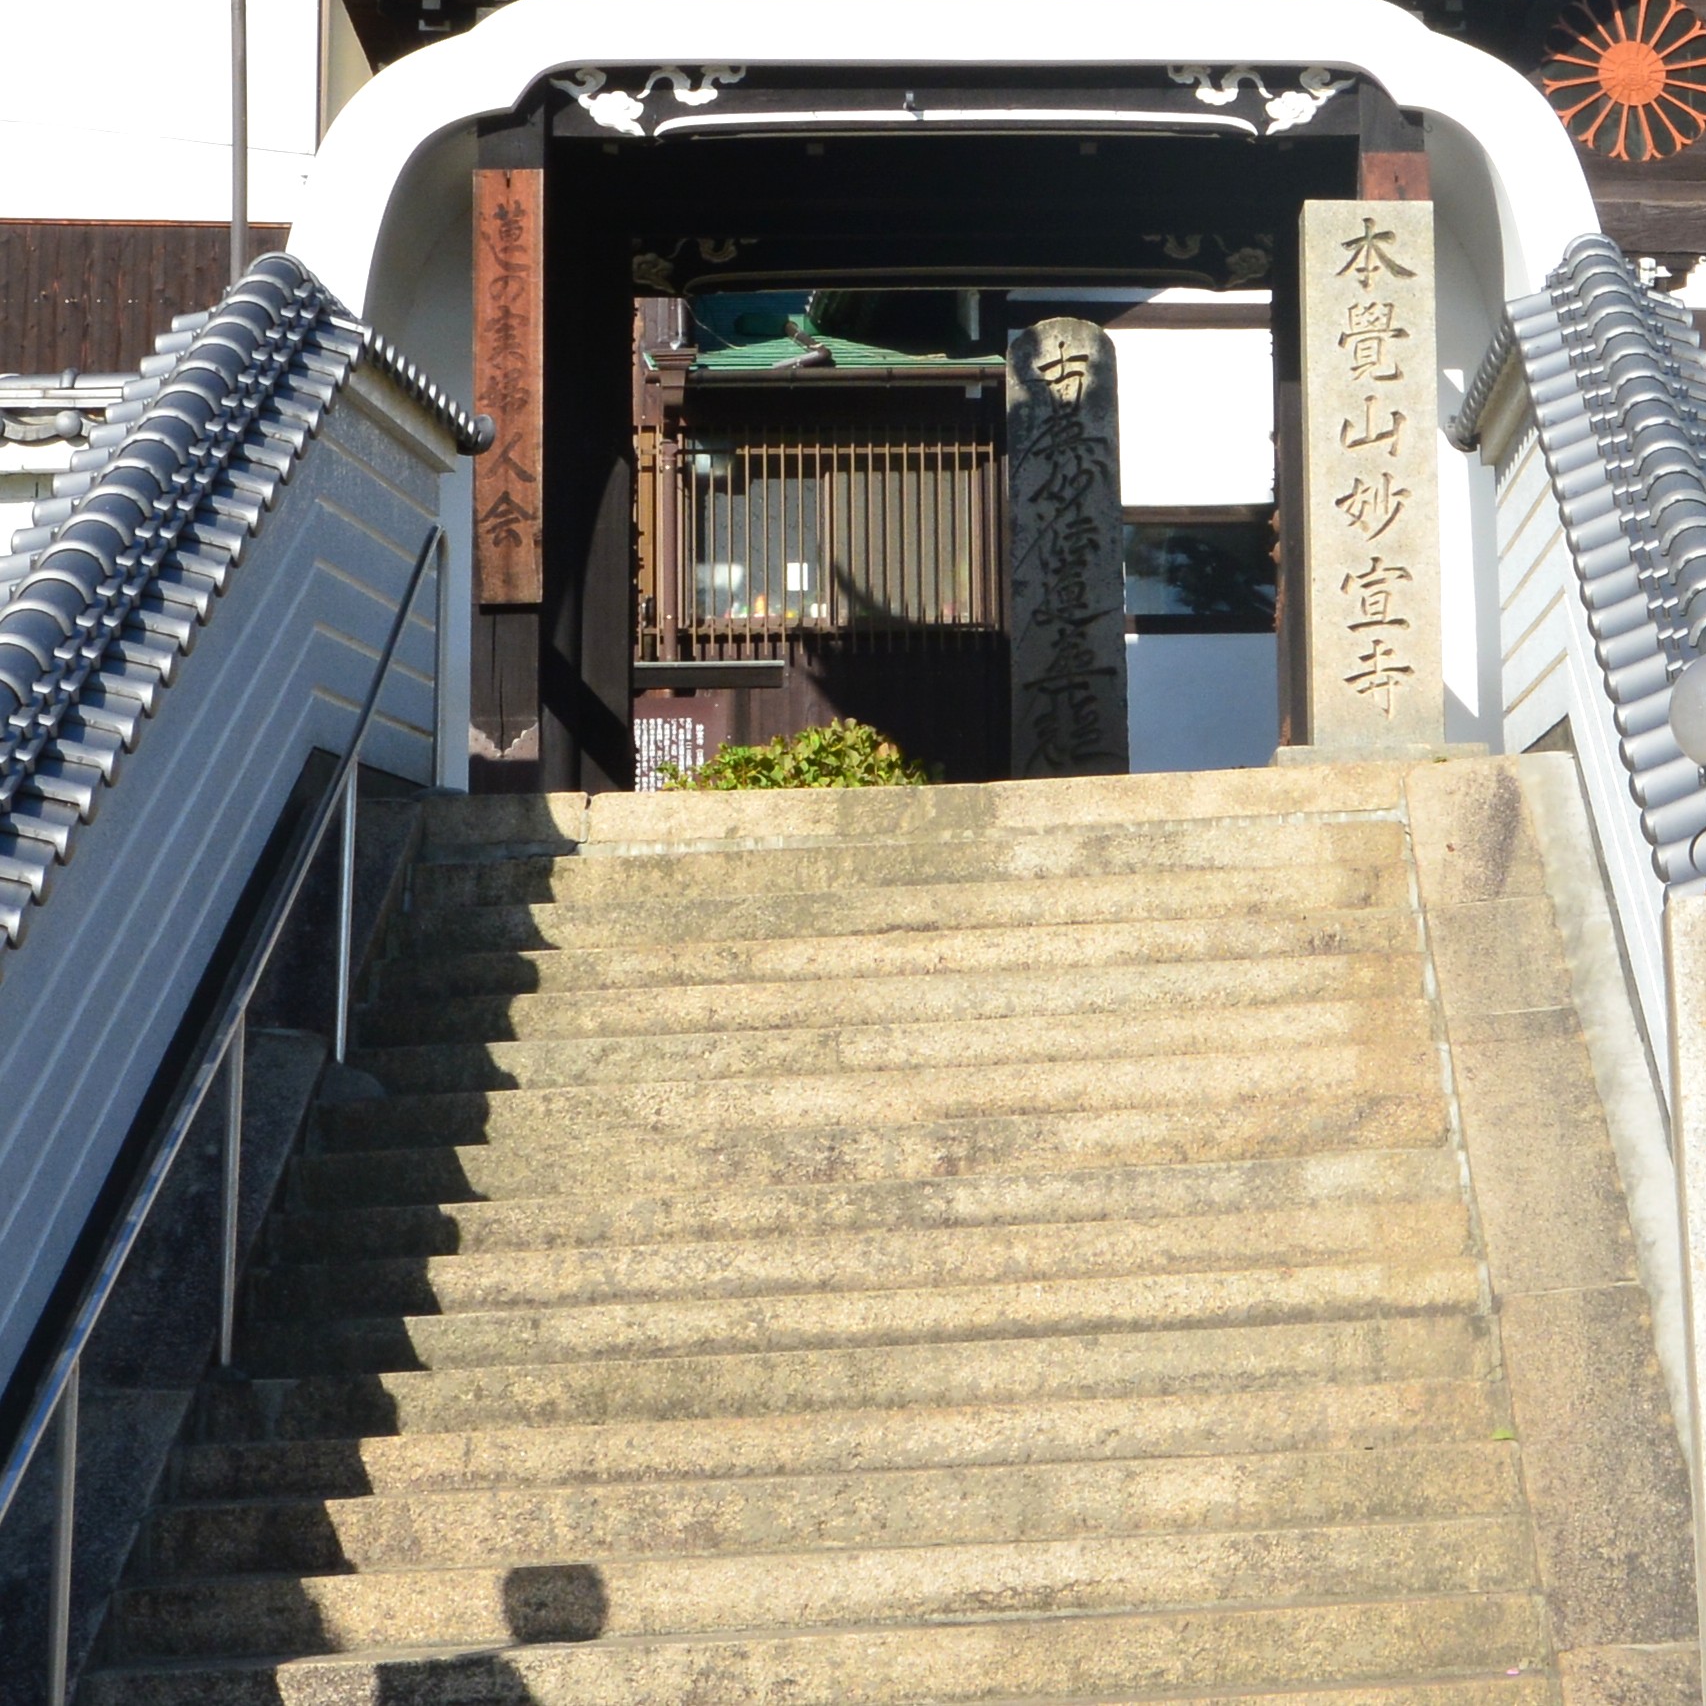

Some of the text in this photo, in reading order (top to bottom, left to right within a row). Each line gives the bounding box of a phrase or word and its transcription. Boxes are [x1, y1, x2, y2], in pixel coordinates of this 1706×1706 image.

[1335, 216, 1418, 720] 本覺山妙宣寺
